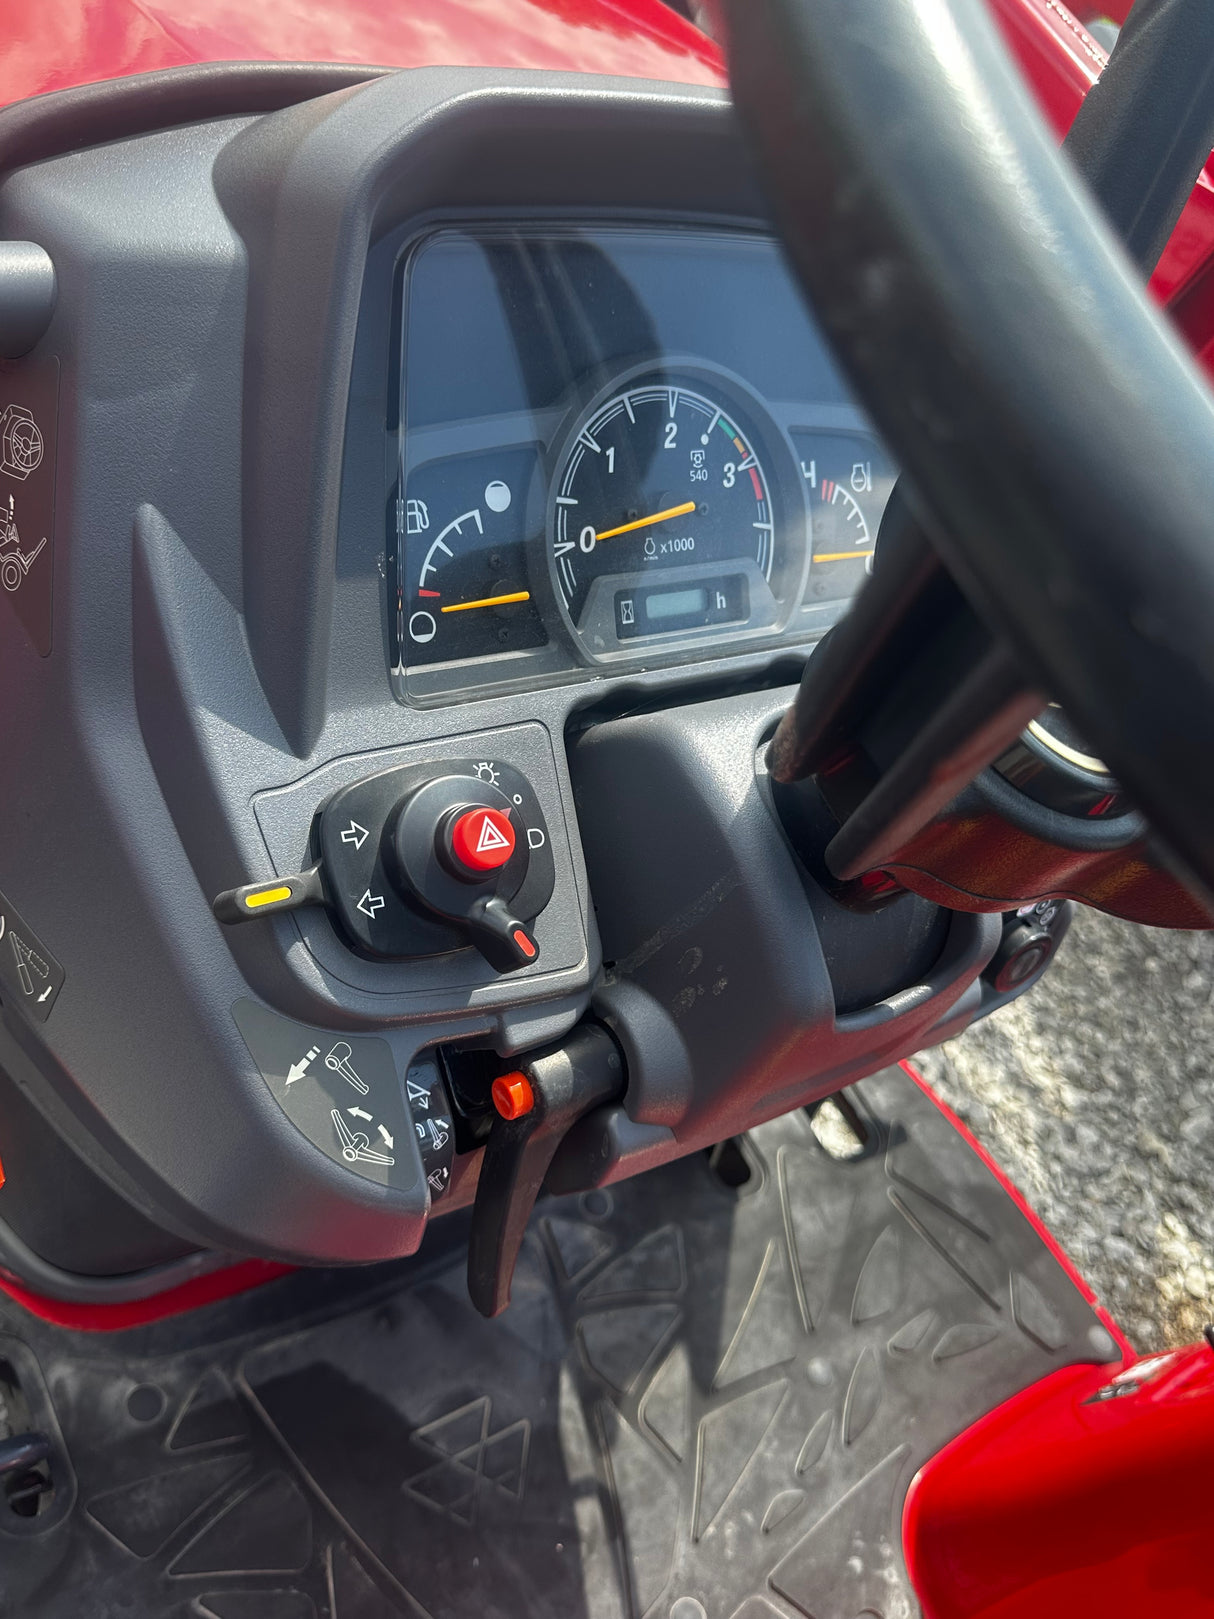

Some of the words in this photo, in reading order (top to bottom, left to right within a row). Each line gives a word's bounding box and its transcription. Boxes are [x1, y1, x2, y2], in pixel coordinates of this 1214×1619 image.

[664, 422, 678, 449] 2
[605, 446, 615, 474] 1
[689, 469, 708, 482] 540
[722, 462, 736, 488] 3
[579, 525, 597, 553] 0
[660, 537, 695, 554] x1000
[716, 591, 727, 609] h
